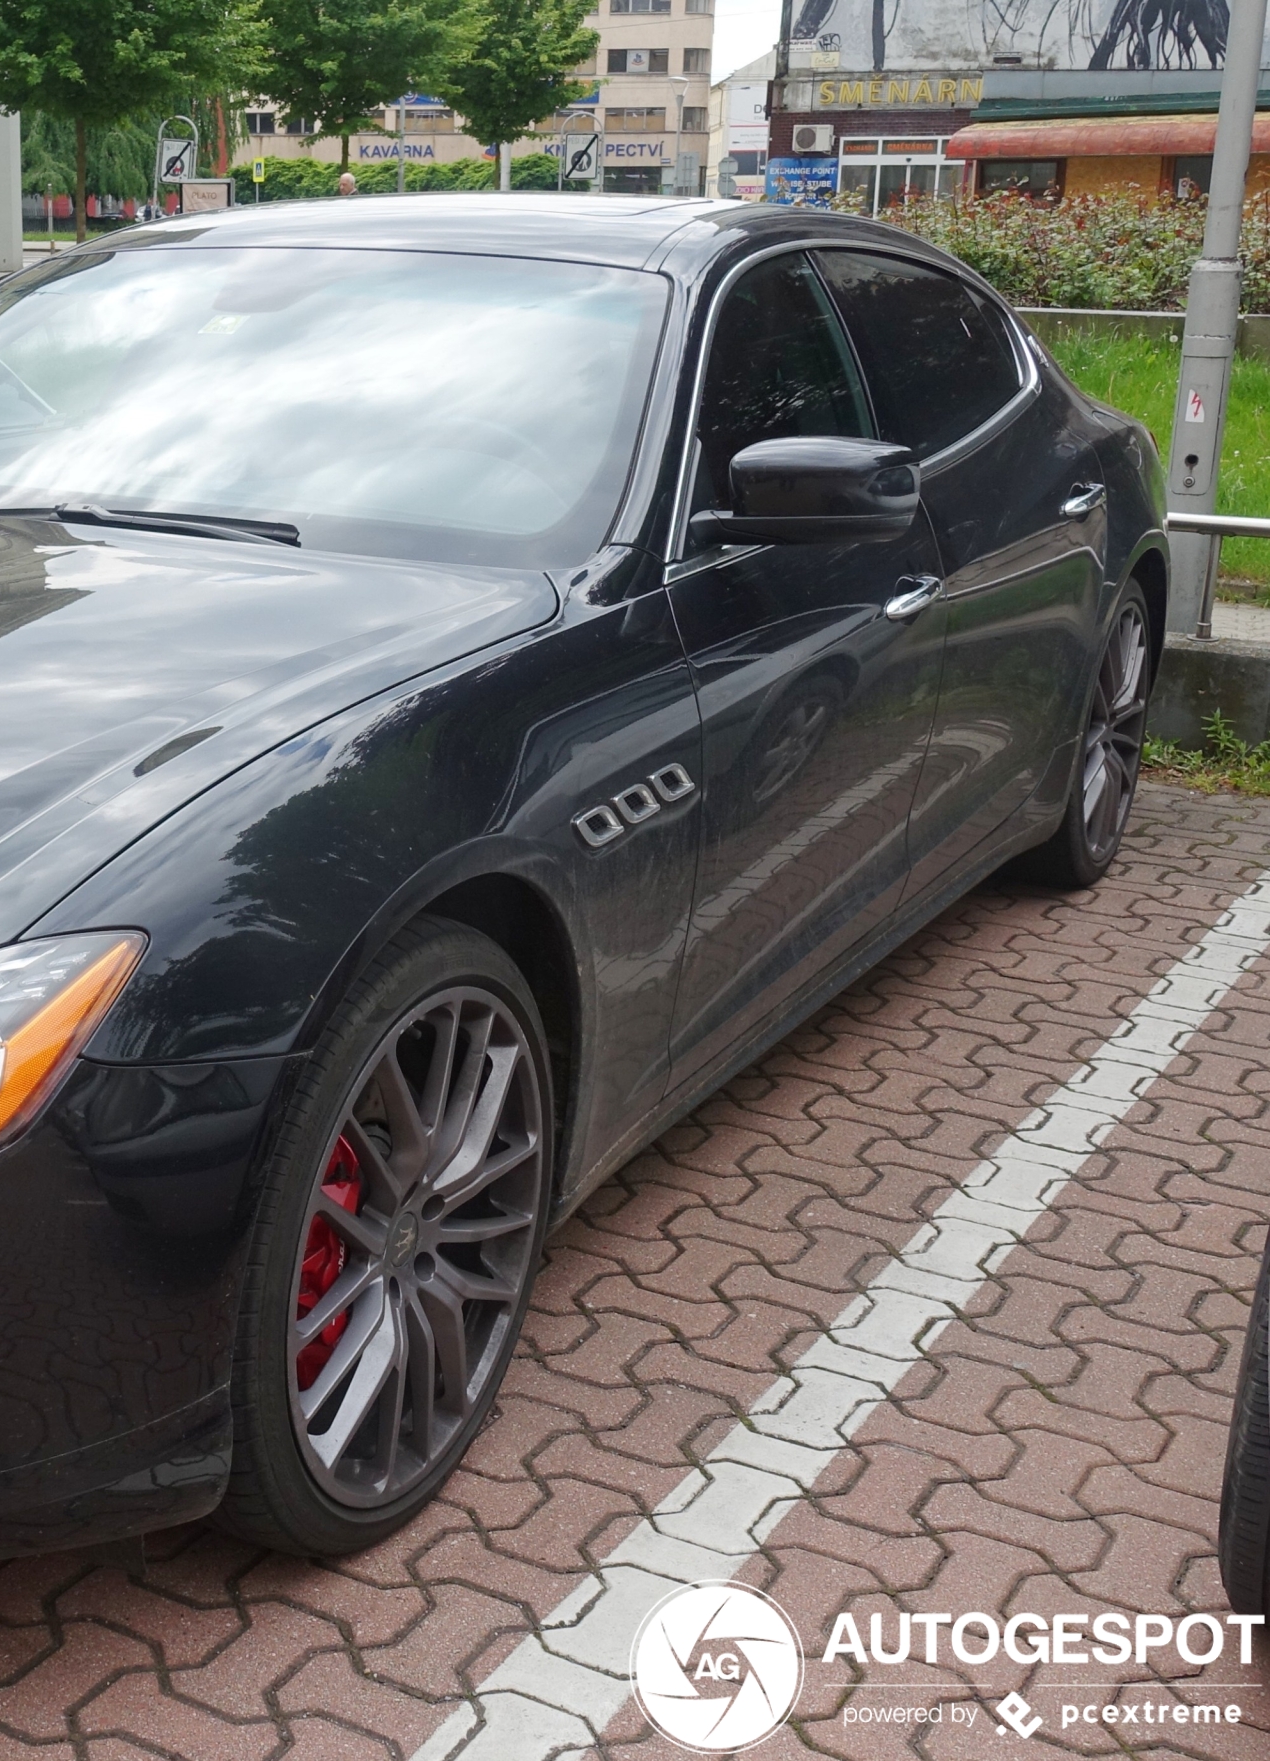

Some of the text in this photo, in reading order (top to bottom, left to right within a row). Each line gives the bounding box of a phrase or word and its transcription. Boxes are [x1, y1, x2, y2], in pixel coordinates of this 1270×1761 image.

[819, 75, 983, 105] SMĚNÁRN
[360, 142, 435, 158] KAVÁRNA
[544, 140, 665, 157] KNPECTVÍ
[191, 191, 217, 199] PLATO
